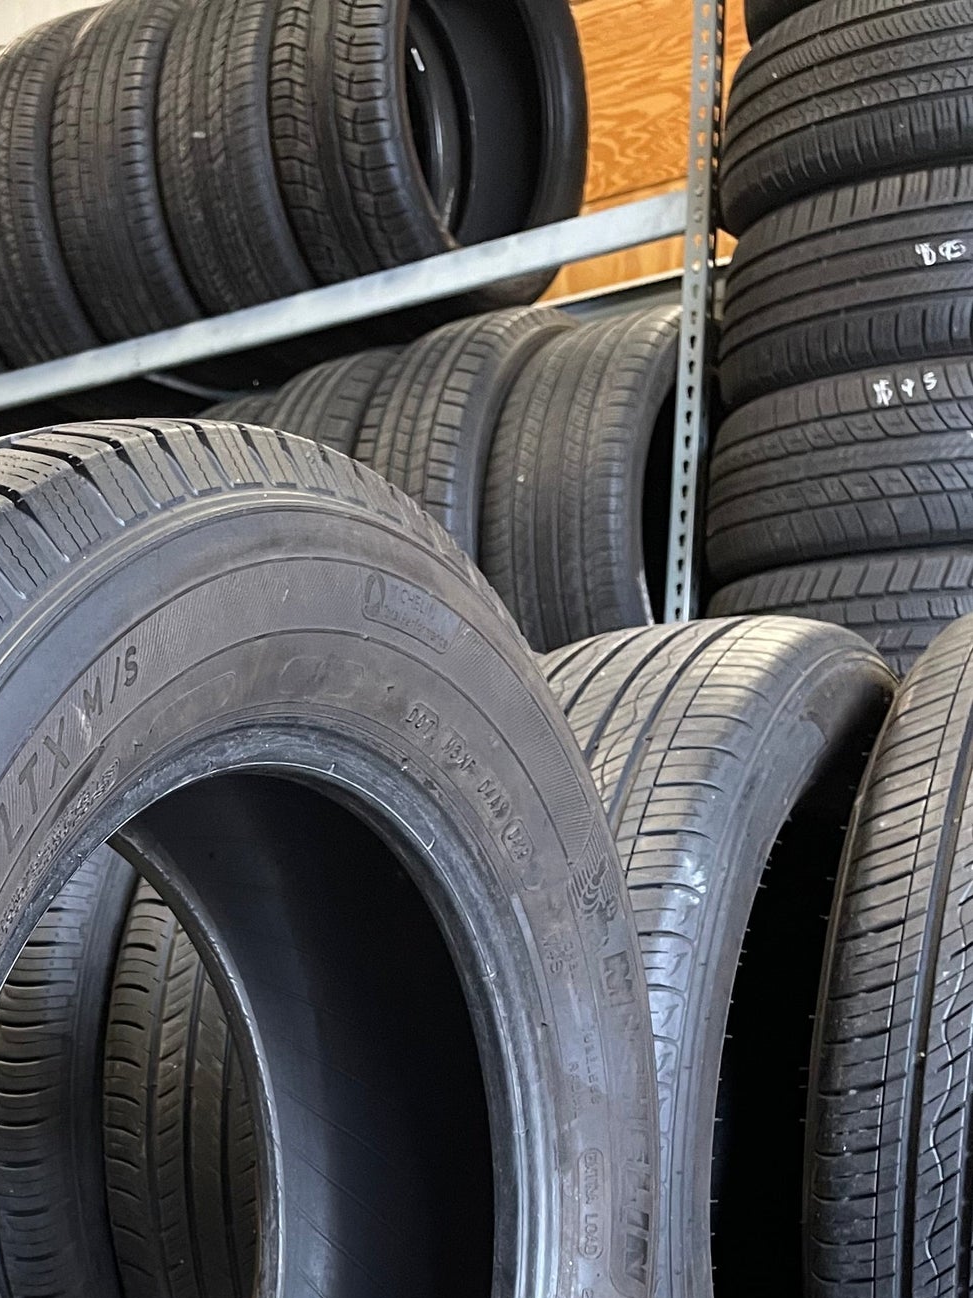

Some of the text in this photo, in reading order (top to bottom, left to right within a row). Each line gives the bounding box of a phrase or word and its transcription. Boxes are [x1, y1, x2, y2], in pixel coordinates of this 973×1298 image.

[404, 706, 437, 735] DOT
[0, 715, 69, 850] LTX
[82, 645, 140, 733] M/S
[583, 1213, 600, 1256] LOAD
